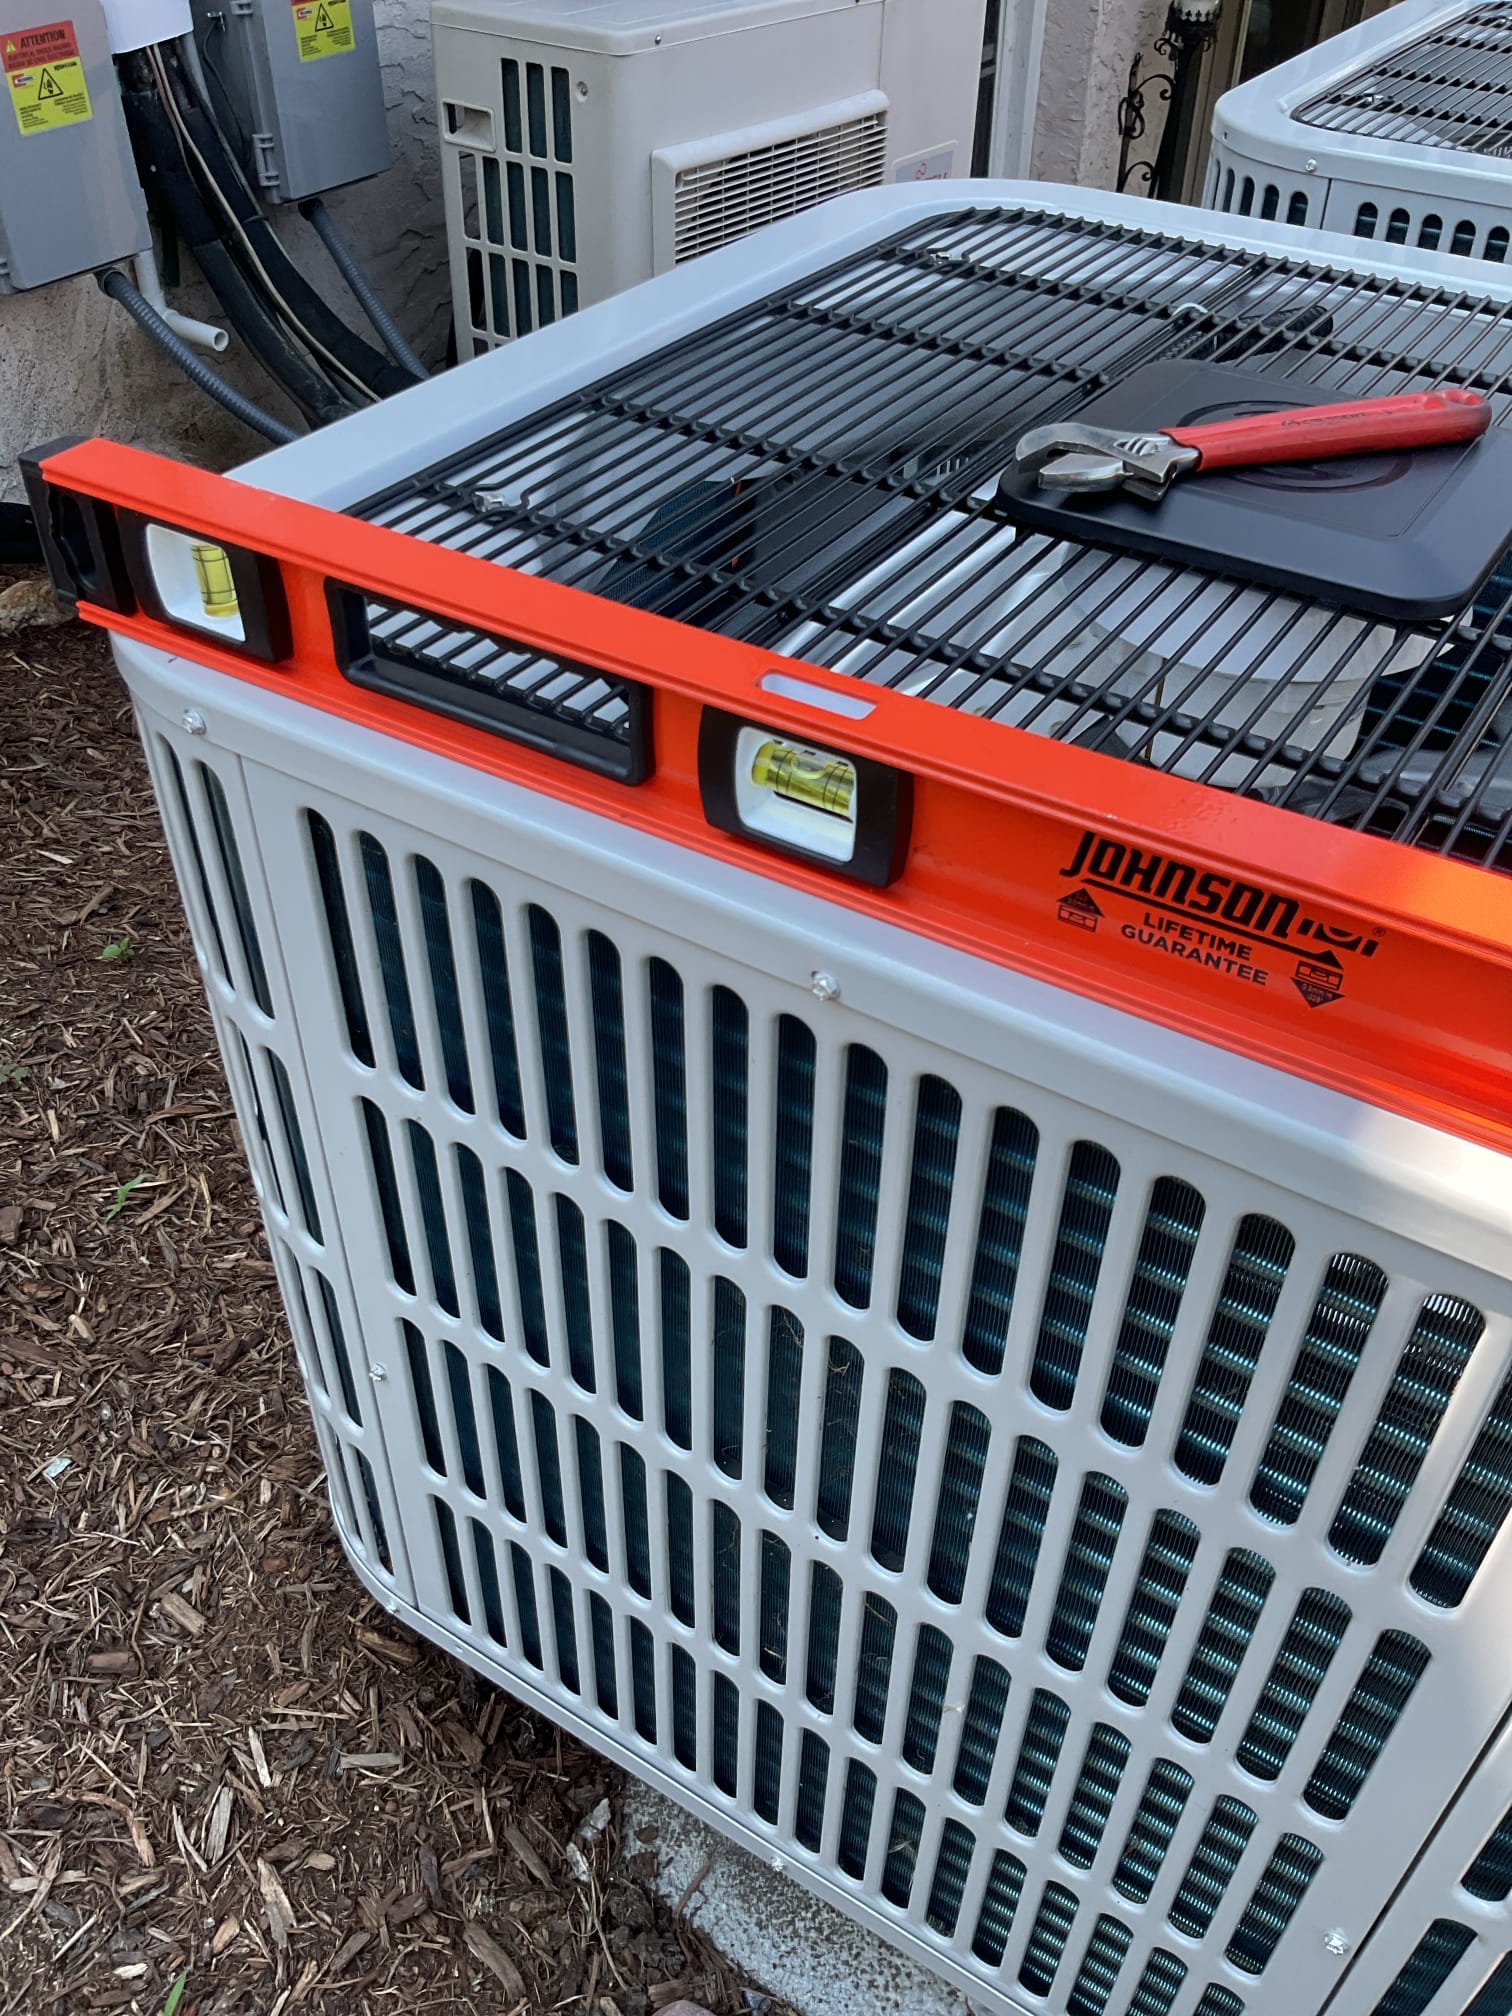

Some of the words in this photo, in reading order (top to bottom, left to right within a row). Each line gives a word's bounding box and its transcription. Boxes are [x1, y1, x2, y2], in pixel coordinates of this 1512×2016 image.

[20, 29, 66, 49] ATTENTION
[1059, 830, 1301, 939] JOHNSON
[1120, 925, 1269, 986] GUARANTEE
[1143, 912, 1253, 961] LIFETIME
